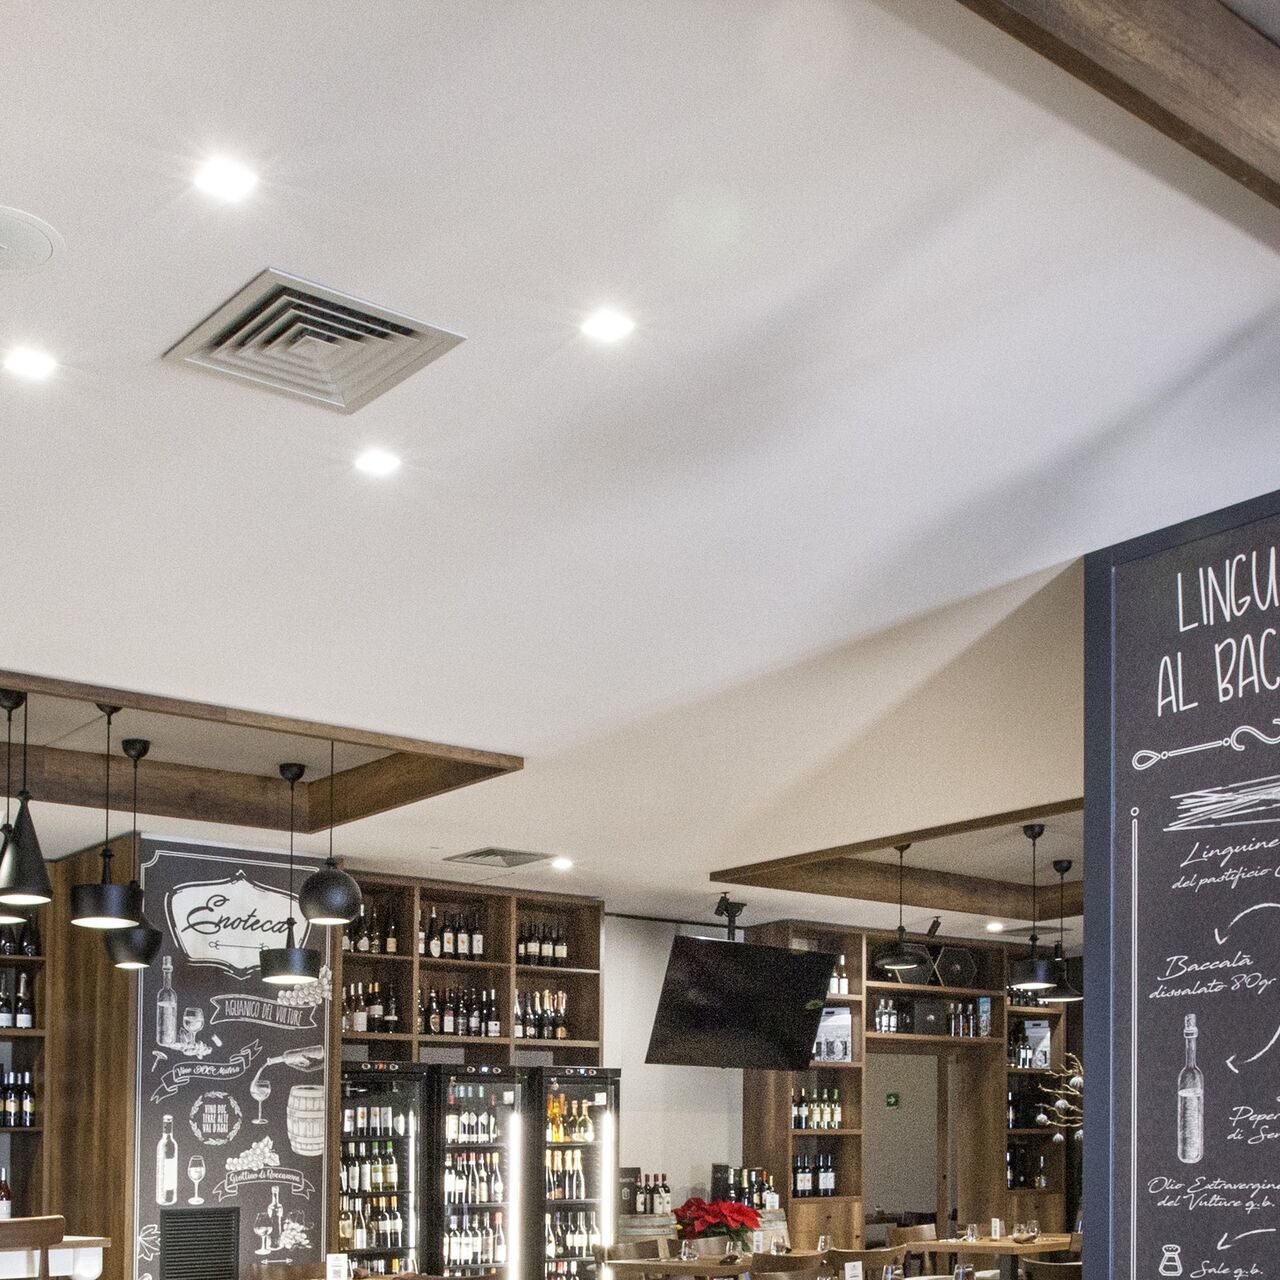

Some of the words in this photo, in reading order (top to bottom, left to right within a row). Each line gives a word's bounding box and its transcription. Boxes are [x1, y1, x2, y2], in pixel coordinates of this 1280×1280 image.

[1157, 651, 1199, 718] AL
[1171, 874, 1196, 890] del
[1195, 865, 1272, 893] pastificio
[181, 894, 294, 936] Enoteca
[1148, 979, 1228, 999] dissalato
[1231, 973, 1278, 996] 80gr
[262, 1003, 274, 1021] DEL
[276, 1006, 303, 1026] VULTURE
[1226, 1128, 1244, 1140] di
[1147, 1176, 1186, 1194] Olio
[1157, 1195, 1181, 1207] del
[1183, 1193, 1243, 1211] Vulture
[1190, 1260, 1231, 1279] Sale
